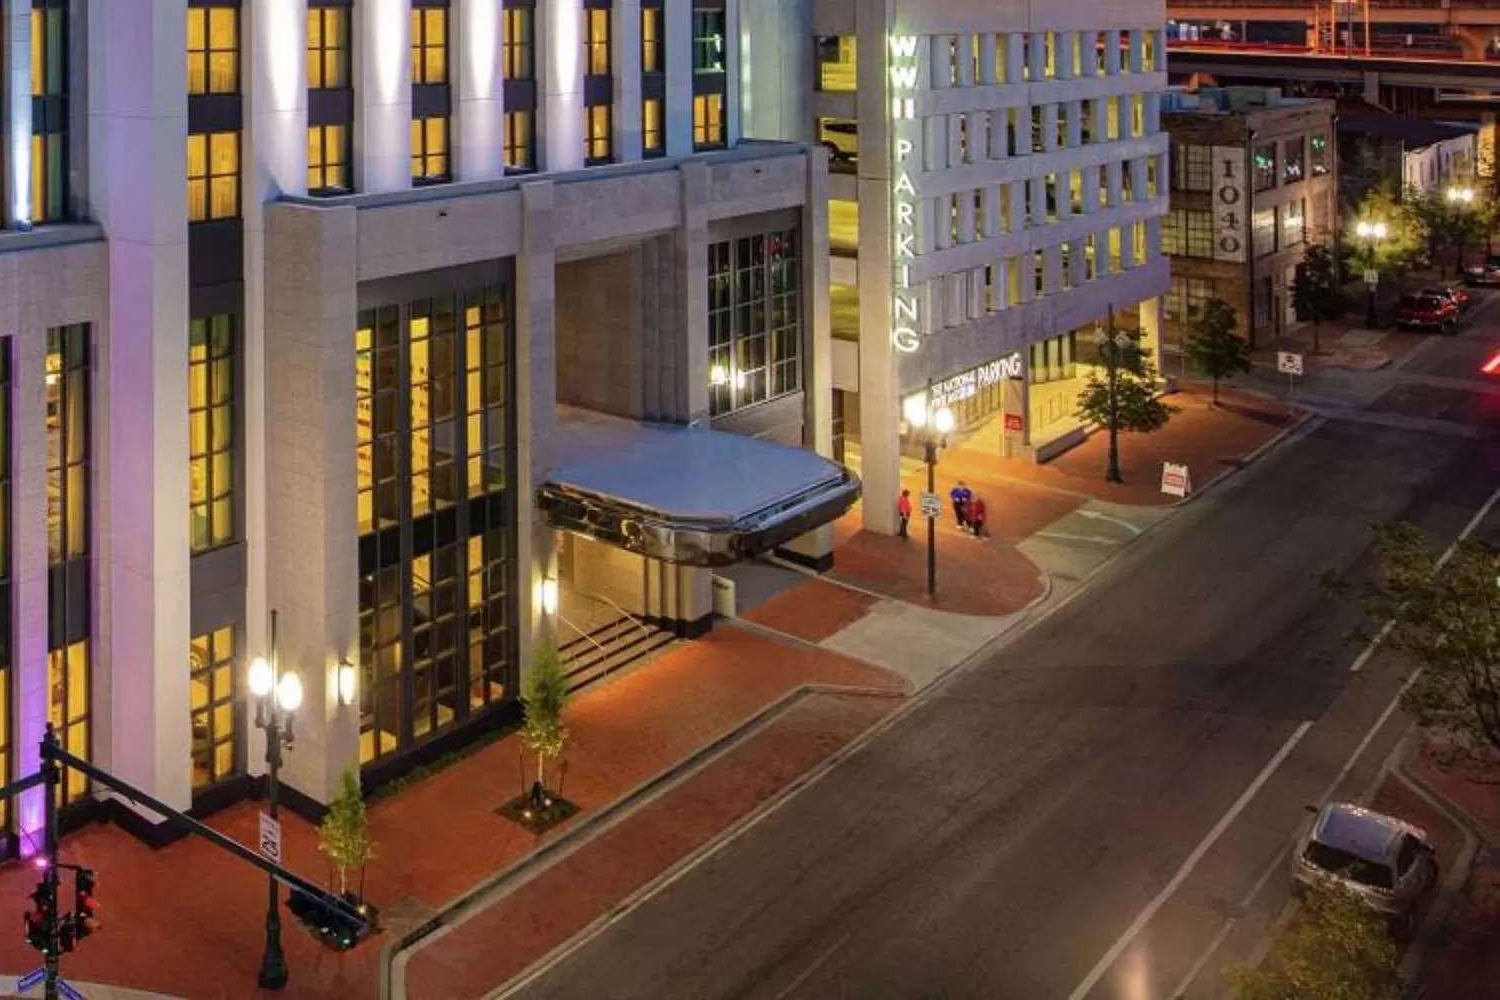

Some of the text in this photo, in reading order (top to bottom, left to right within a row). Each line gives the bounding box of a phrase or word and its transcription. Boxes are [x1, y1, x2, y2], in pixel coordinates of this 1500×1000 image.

[889, 34, 920, 353] WWII PARKING
[1220, 158, 1240, 253] 1040
[977, 352, 1021, 388] PARKING
